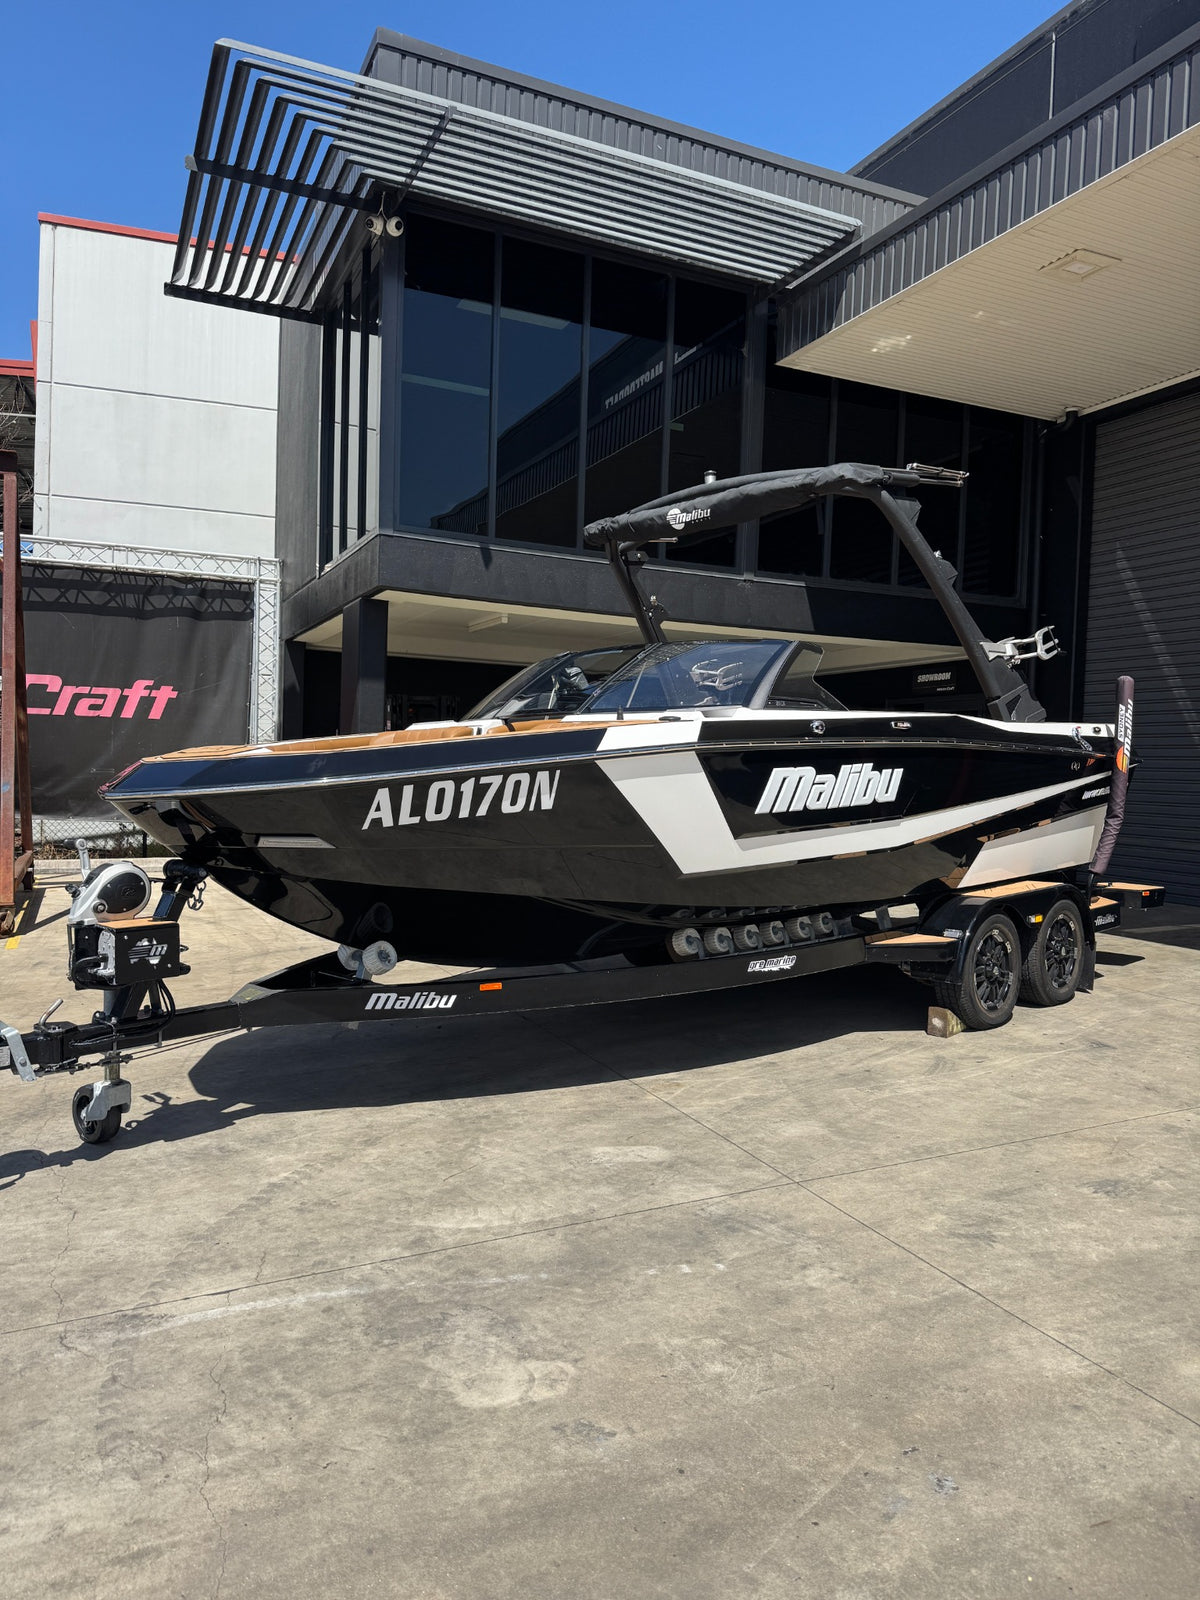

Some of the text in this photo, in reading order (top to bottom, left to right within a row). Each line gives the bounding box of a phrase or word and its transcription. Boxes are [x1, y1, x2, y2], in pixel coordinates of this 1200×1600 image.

[676, 508, 711, 524] Malibu
[917, 671, 952, 683] SHOWROOM
[25, 673, 179, 720] Craft
[754, 762, 904, 815] Malibu
[364, 991, 458, 1010] Malibu
